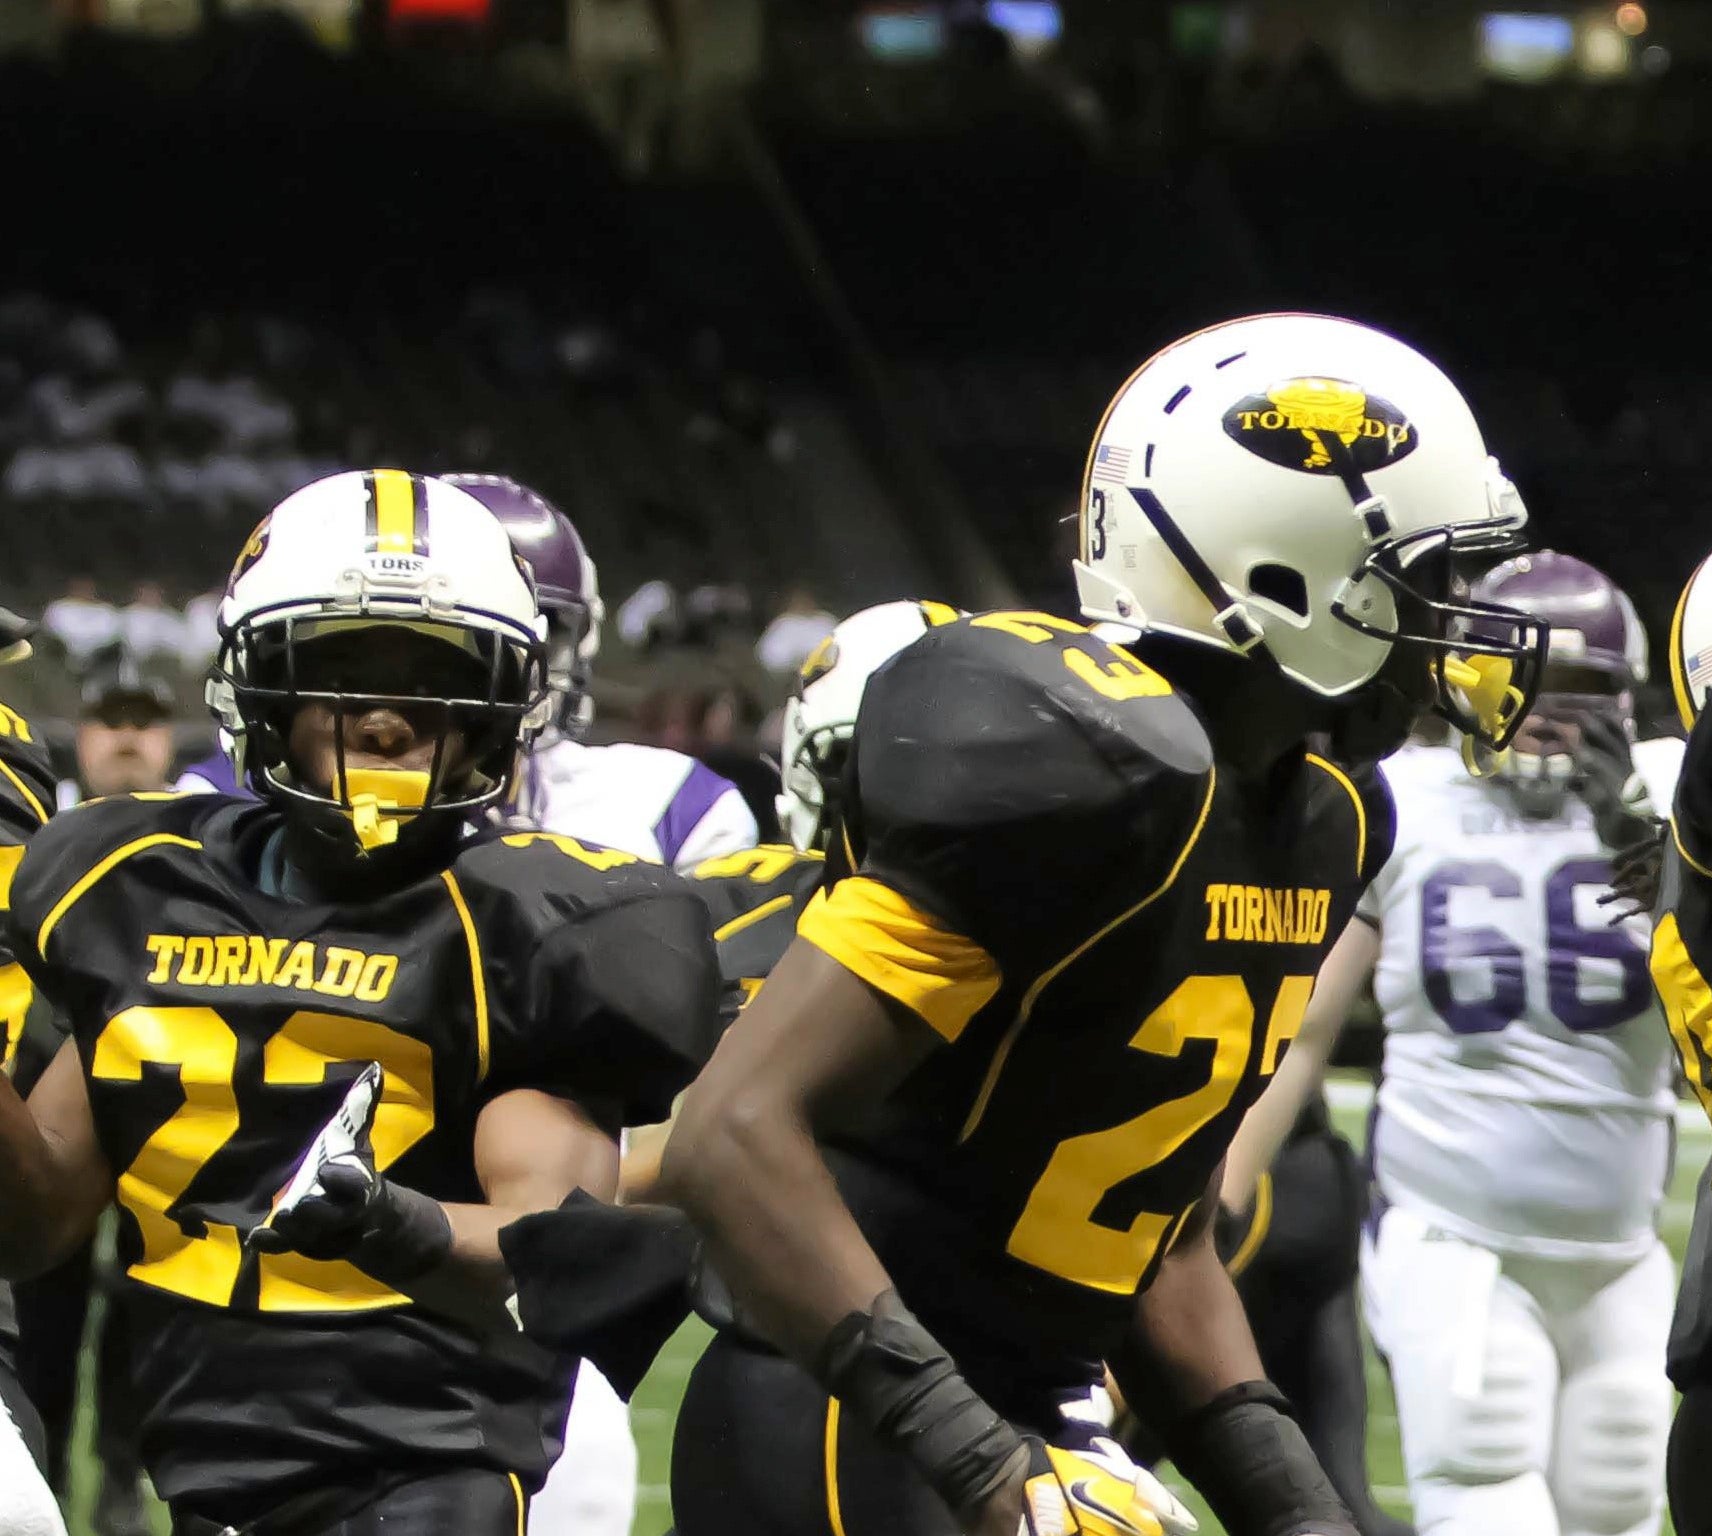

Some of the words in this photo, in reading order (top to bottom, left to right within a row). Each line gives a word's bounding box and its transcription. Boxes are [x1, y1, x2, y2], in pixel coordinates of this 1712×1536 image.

[145, 934, 400, 1003] TORNADO
[1205, 883, 1332, 945] TORNADO
[1420, 857, 1655, 1034] 66
[92, 1005, 436, 1312] 22
